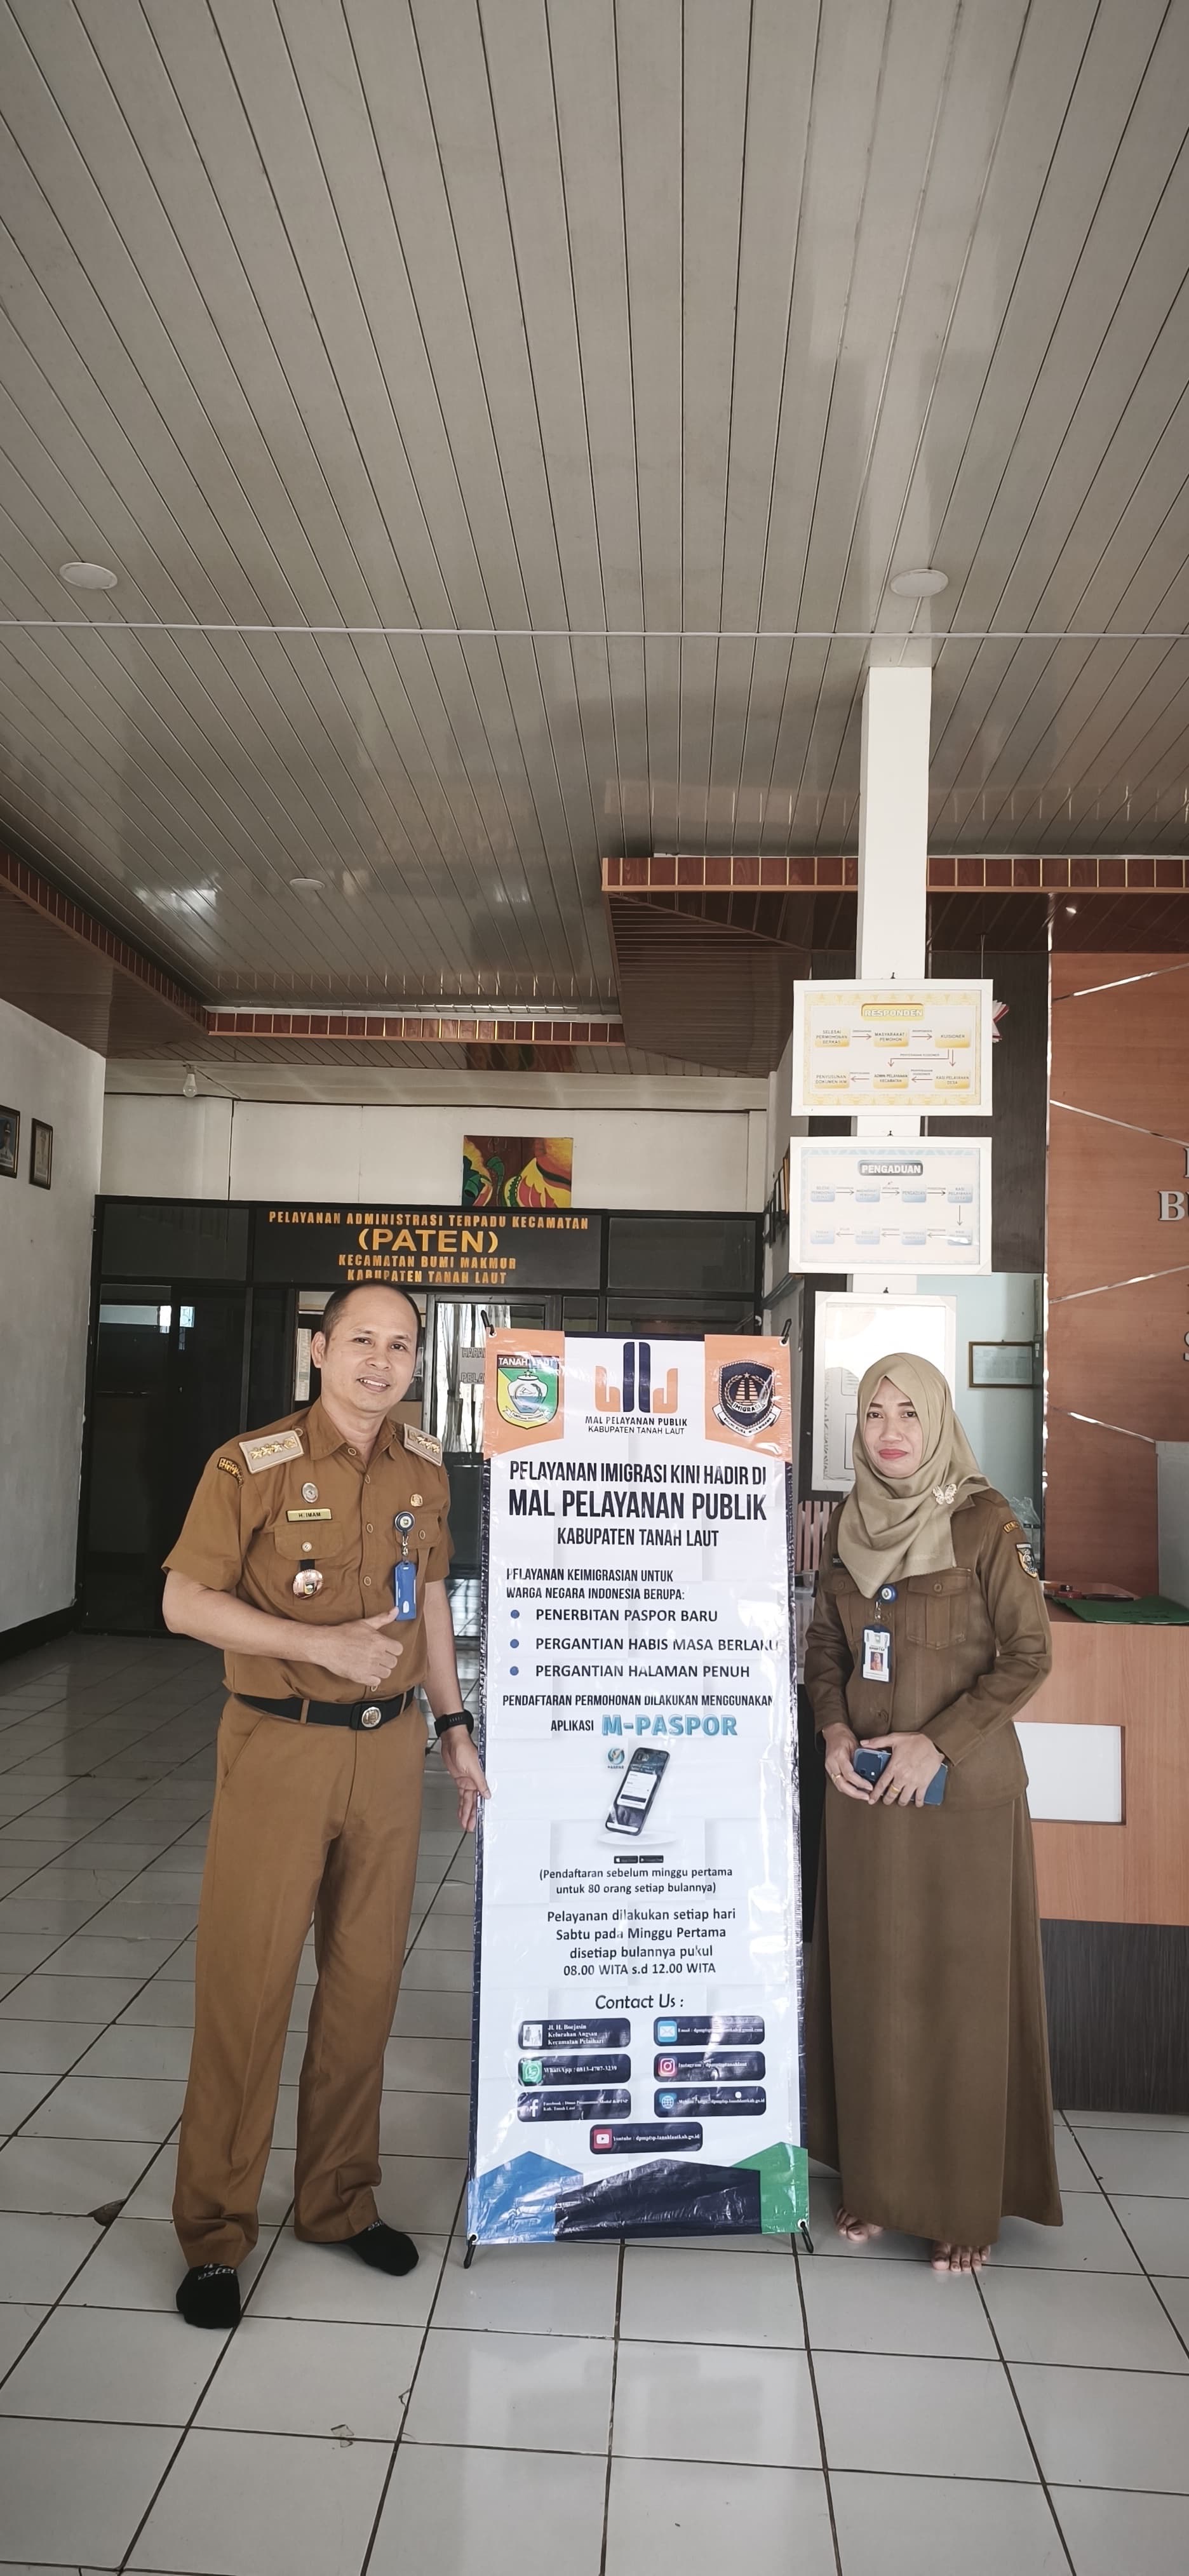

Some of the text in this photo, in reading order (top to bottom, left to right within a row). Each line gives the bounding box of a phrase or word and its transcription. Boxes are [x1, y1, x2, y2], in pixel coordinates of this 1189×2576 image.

[862, 1164, 921, 1174] PENGADUAN
[269, 1211, 588, 1230] PELAYANAN ADMINISTRASI TERPADU KECAMATAN
[358, 1228, 498, 1253] (PATEN)
[339, 1254, 516, 1270] KECAMATAN BUMI MAKMUR
[347, 1268, 507, 1284] KABUPATEN TANAH LAUT
[585, 1416, 688, 1426] MAL PELAYANAN PUBLIK
[588, 1425, 635, 1434] KABUPATEN
[637, 1426, 662, 1435] TANAH
[510, 1460, 766, 1486] PELAYANAN IMIGRASI KINI HADIR DI
[509, 1489, 767, 1521] MAL PELAYANAN PUBLIK
[557, 1527, 719, 1547] KABUPATEN TANAH LAUT
[567, 1569, 638, 1582] KEIMIGRASIAN
[641, 1569, 674, 1582] UNTUK
[506, 1587, 685, 1600] WARGA NEGARA INDONESIA BERUPA:
[535, 1608, 718, 1622] PENERBITAN PASPOR BARU
[535, 1637, 779, 1651] PERGANTIAN HABIS MASA BERLAKU
[535, 1665, 749, 1678] PERGANTIAN HALAMAN PENUH
[502, 1694, 773, 1707] PENDAFTARAN PERMOHONAN DILAKUKAN MENGGUNAKAN
[551, 1714, 738, 1736] APLIKASI M-PASPOR
[539, 1868, 732, 1881] (Pendaftaran sebelum minggu pertama
[556, 1882, 716, 1895] untuk 80 orang setiap bulannya)
[547, 1909, 736, 1924] Pelayanan dilakukan setiap hari
[556, 1927, 727, 1942] Sabtu pada Minggu Pertama
[570, 1945, 713, 1961] disetiap bulannya pukul
[563, 1962, 716, 1976] 08.00 WITA s.d 12.00 WITA
[595, 1994, 654, 2009] Contact
[659, 1994, 676, 2008] Us
